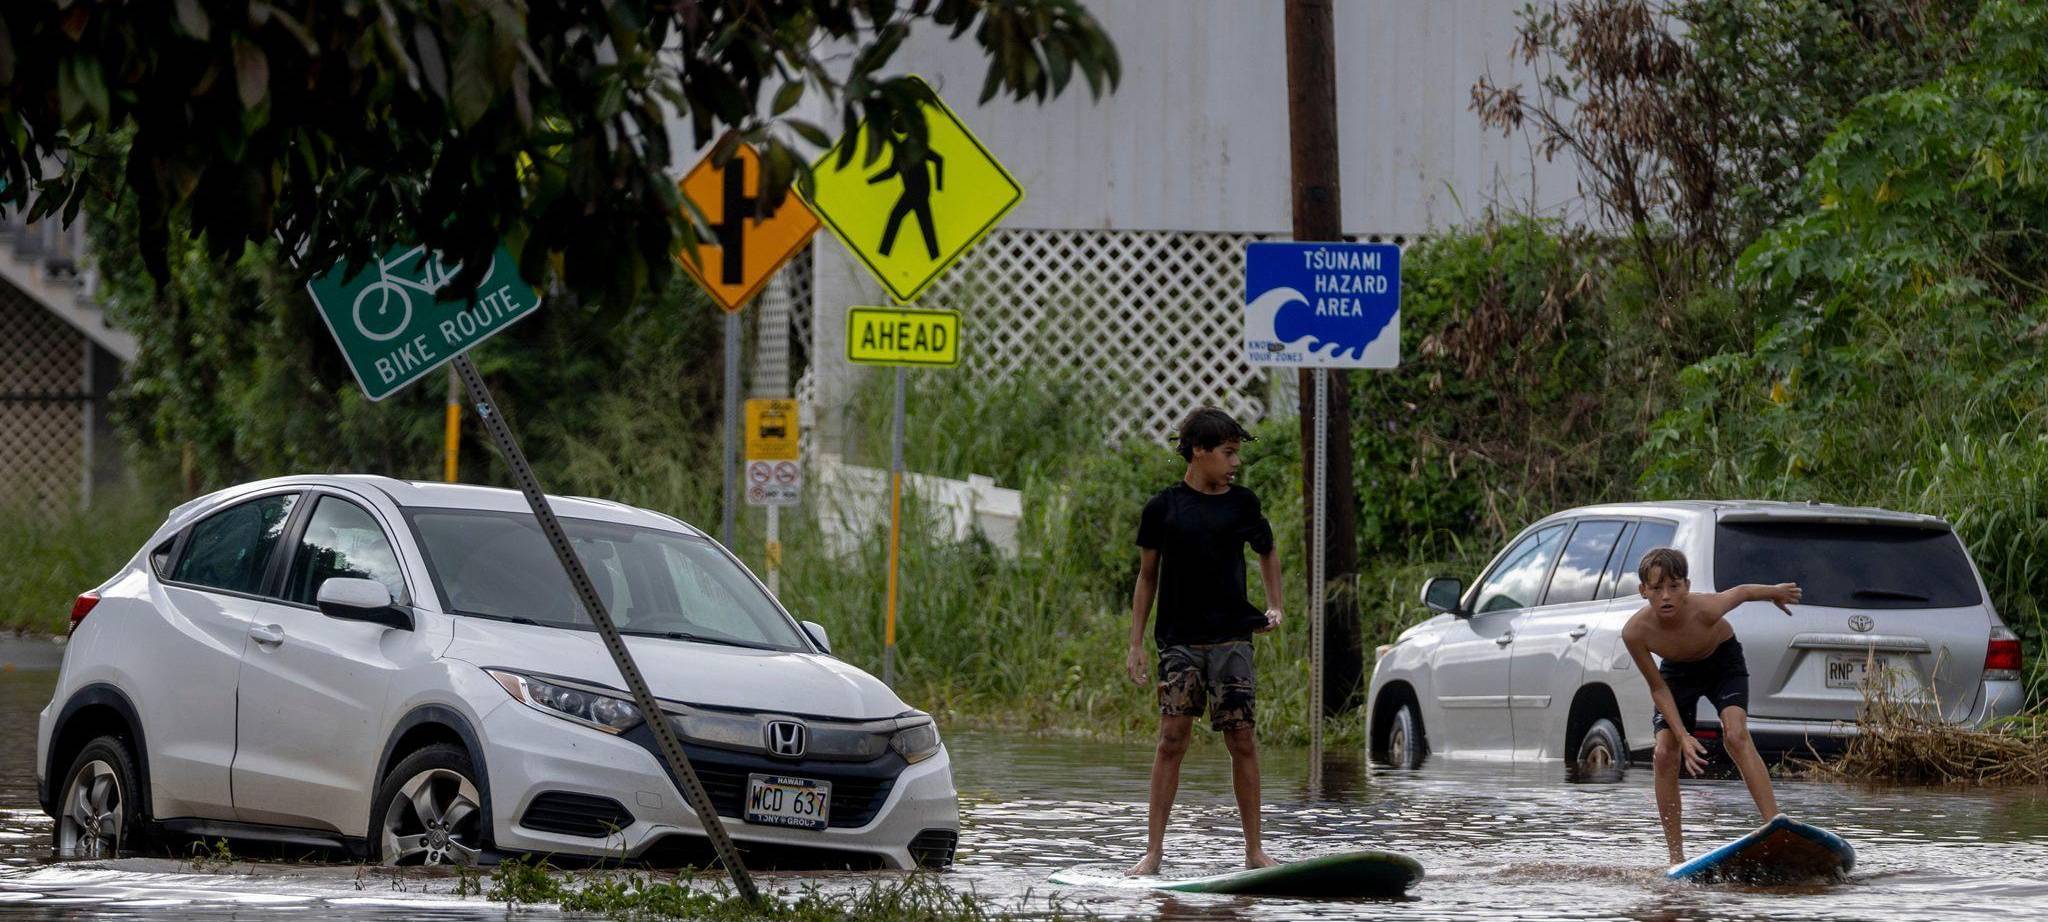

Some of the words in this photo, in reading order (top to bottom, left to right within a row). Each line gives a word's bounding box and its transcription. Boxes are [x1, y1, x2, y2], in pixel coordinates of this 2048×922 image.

[1303, 250, 1381, 271] TSUNAMI
[1315, 274, 1388, 294] HAZARD
[1315, 298, 1362, 317] AREA
[374, 333, 436, 384] BIKE
[439, 284, 521, 346] ROUTE
[862, 321, 947, 352] AHEAD
[1248, 351, 1272, 361] YOUR
[1275, 352, 1304, 362] ZONES
[1829, 662, 1854, 680] RNP
[777, 777, 804, 786] HAWAII
[752, 785, 784, 812] WCD
[793, 791, 827, 816] 637
[787, 817, 816, 827] GROUP
